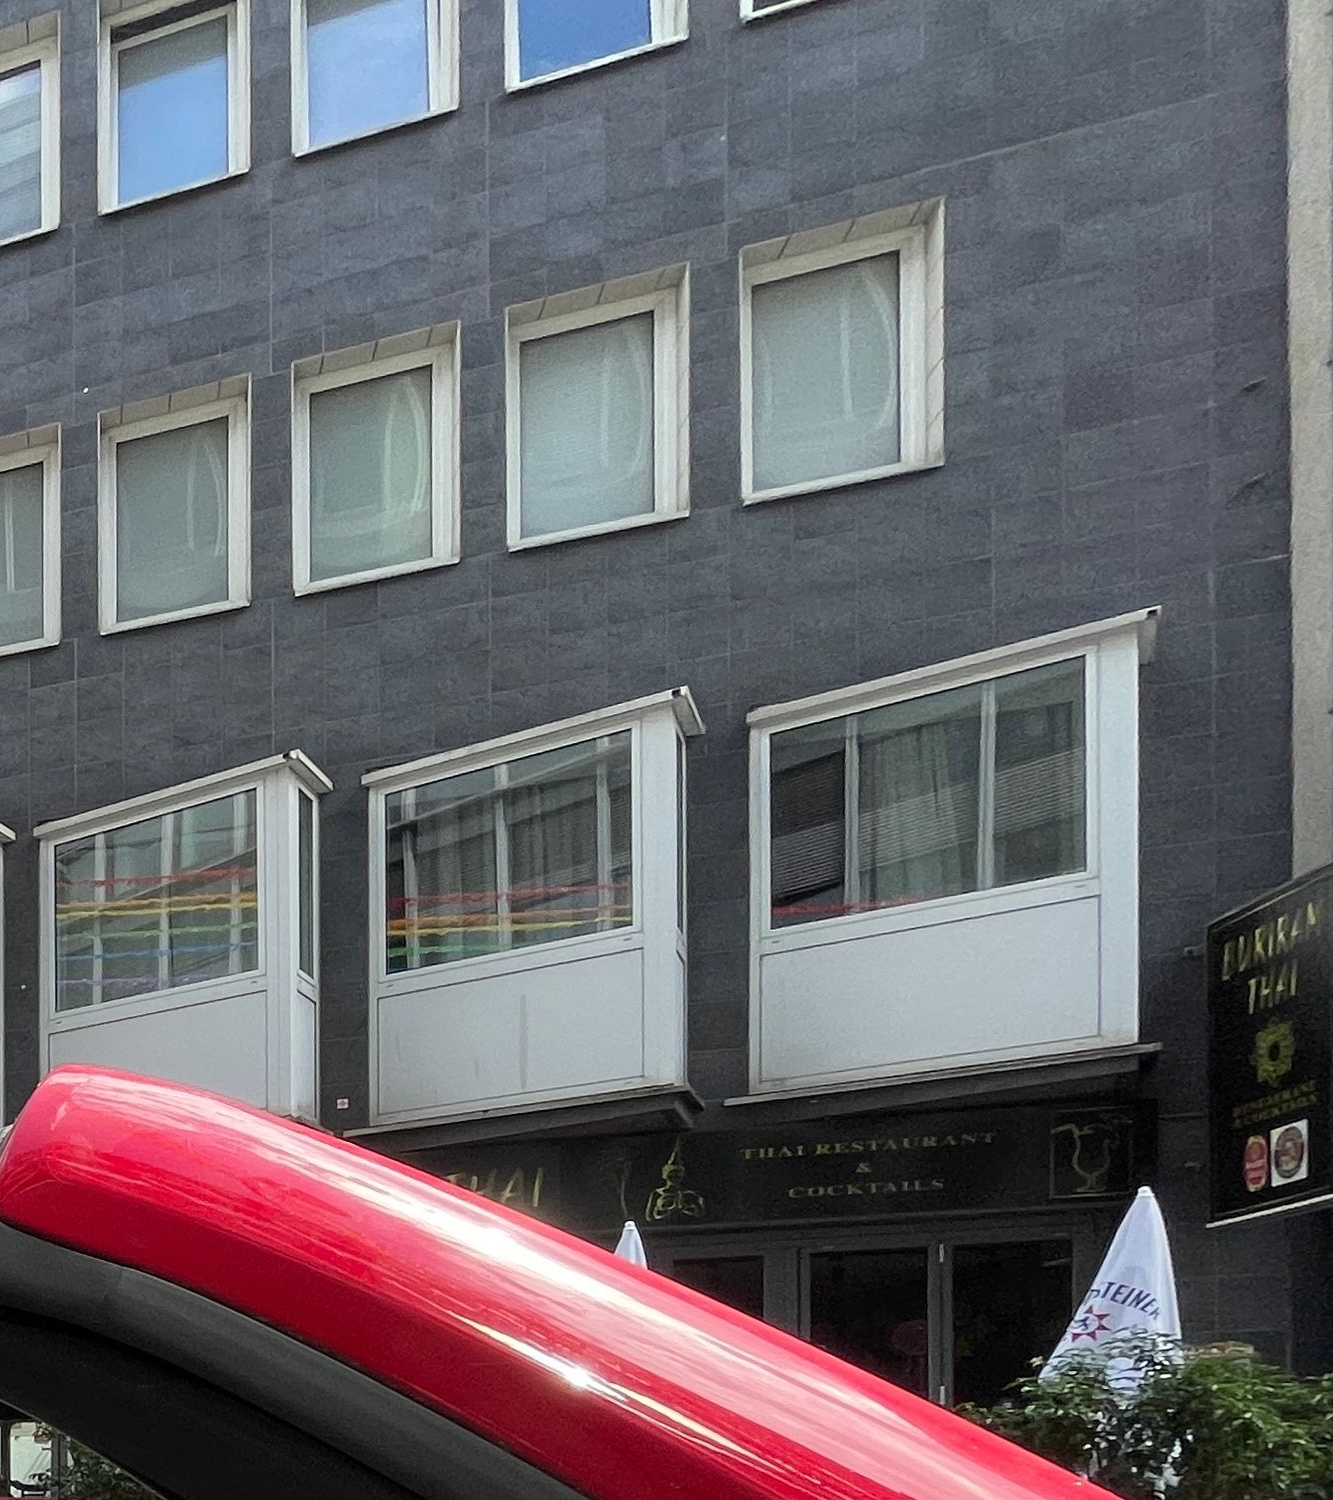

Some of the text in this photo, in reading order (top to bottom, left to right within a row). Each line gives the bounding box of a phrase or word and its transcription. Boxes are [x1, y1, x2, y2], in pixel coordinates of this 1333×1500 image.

[1247, 957, 1300, 1015] THAI
[740, 1131, 998, 1160] THAI RESTAURANT
[788, 1178, 945, 1199] COCKTAILS
